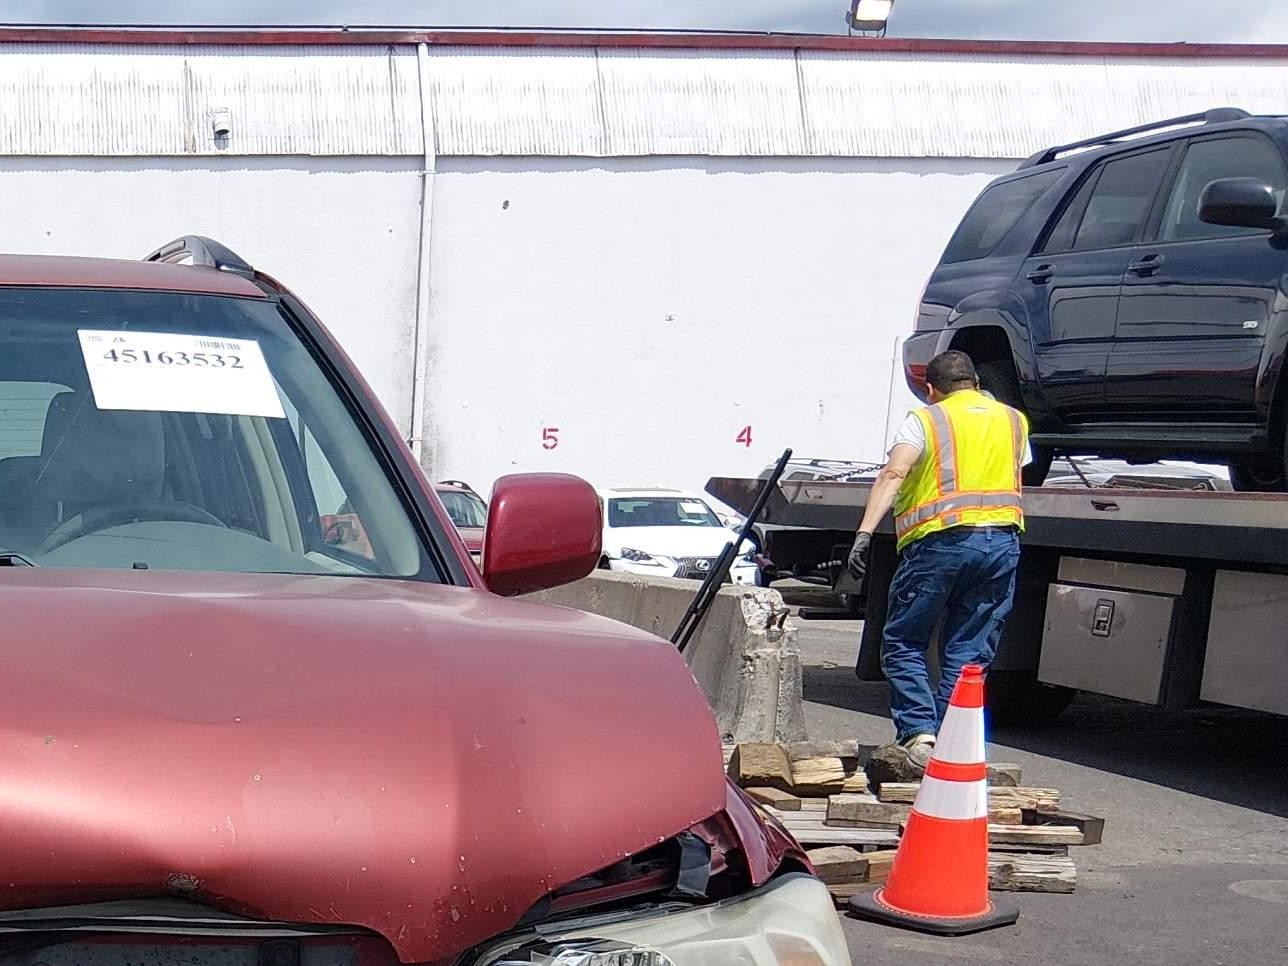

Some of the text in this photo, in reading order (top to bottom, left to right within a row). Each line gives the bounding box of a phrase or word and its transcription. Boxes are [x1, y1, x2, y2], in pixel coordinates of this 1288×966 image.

[102, 348, 245, 369] 45163532
[542, 427, 560, 450] 5
[735, 425, 753, 448] 4
